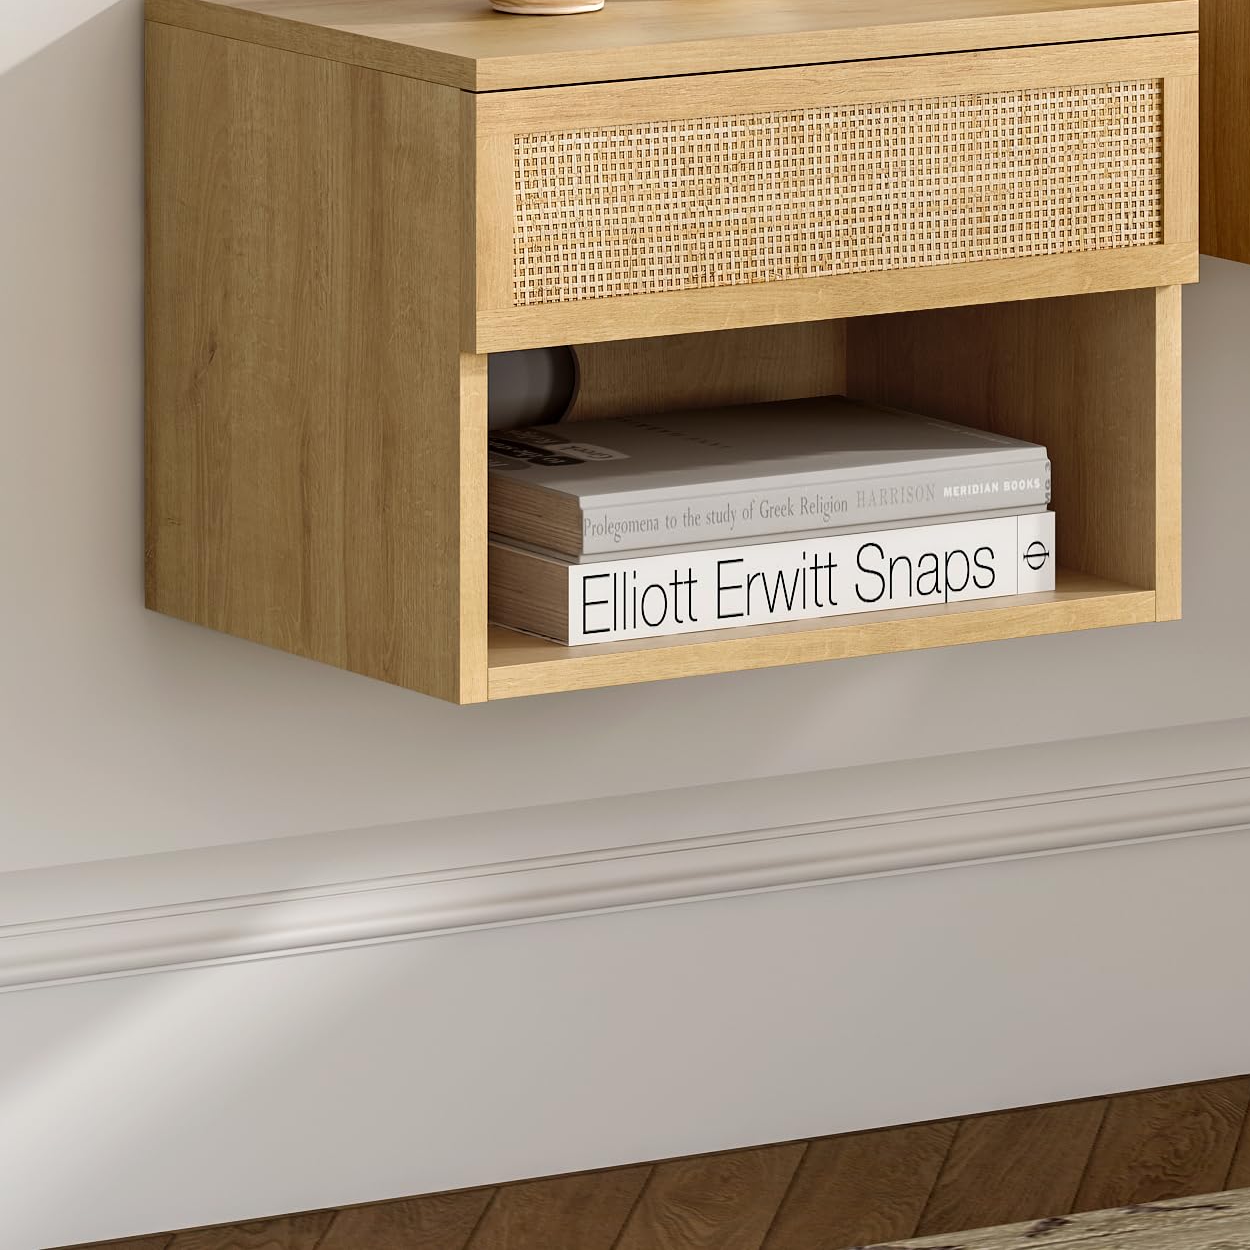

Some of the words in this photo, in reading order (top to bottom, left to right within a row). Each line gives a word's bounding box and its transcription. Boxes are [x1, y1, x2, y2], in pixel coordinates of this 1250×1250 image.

[856, 483, 935, 508] HARRISON
[943, 480, 999, 498] MERIDIAN
[1003, 477, 1040, 491] BOOKS
[583, 513, 659, 543] Prolegomena
[665, 514, 678, 530] to
[683, 507, 701, 527] the
[705, 503, 737, 531] study
[742, 499, 756, 520] of
[759, 497, 794, 519] Greek
[800, 494, 848, 523] Religion
[583, 568, 698, 635] Elliott
[717, 551, 838, 620] Erwitt
[855, 542, 996, 604] Snaps
